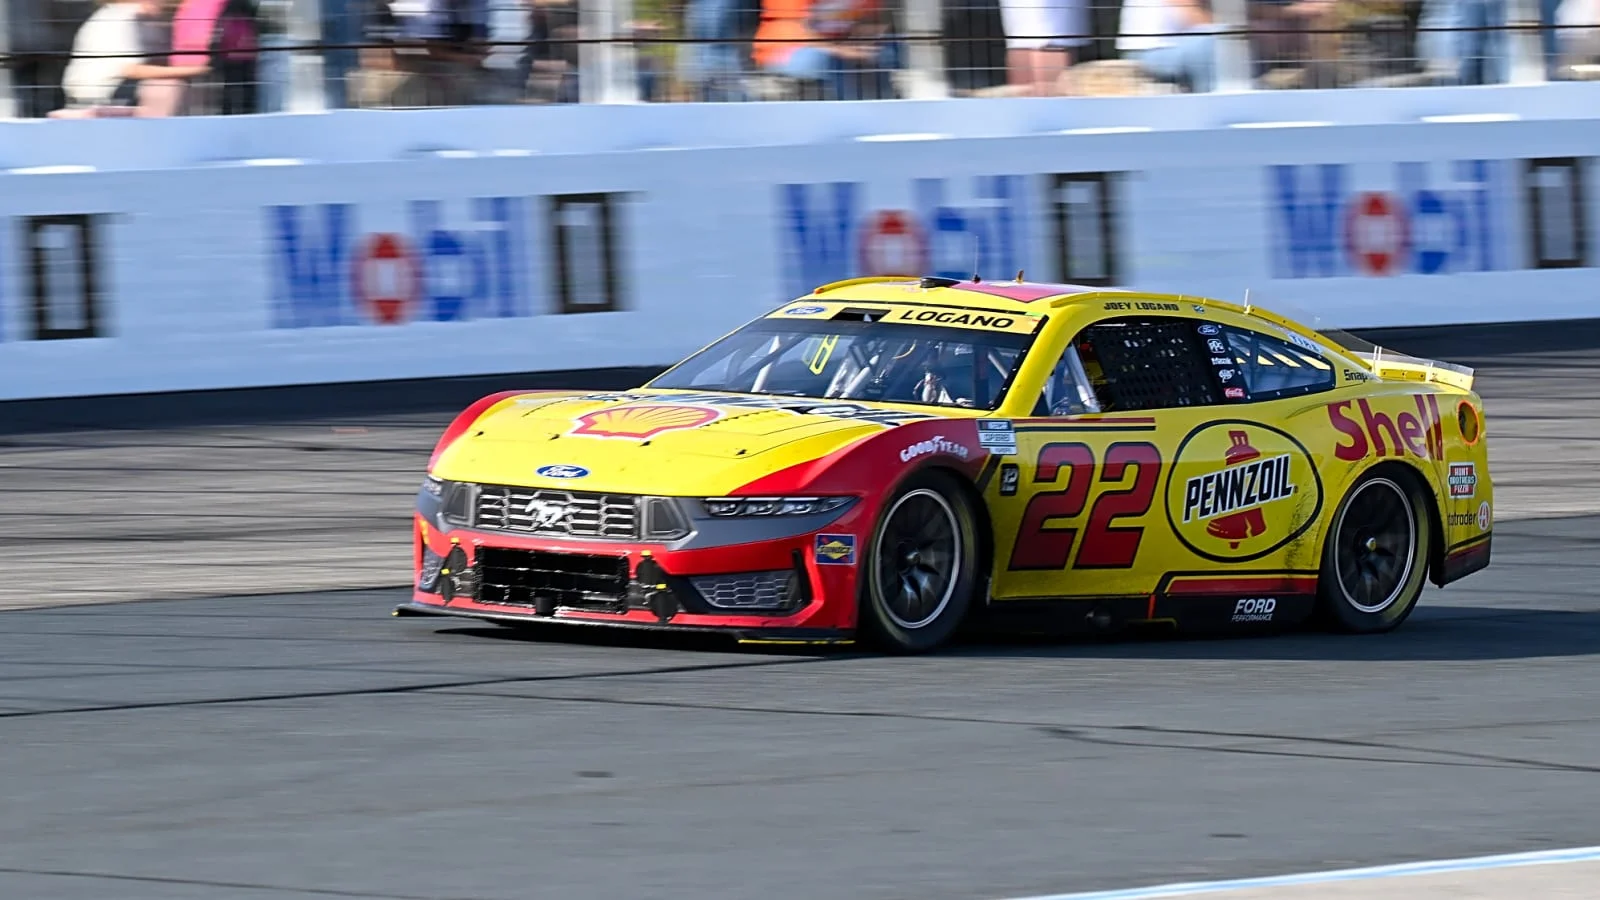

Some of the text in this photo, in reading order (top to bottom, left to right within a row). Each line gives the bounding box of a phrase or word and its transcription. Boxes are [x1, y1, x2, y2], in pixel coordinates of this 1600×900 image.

[1104, 302, 1180, 312] JOEY LOGANO
[900, 309, 1014, 329] LOGANO
[1327, 393, 1444, 461] Shell
[542, 465, 584, 479] Ford
[1185, 456, 1293, 521] PENNZOIL
[1008, 442, 1161, 571] 22
[1233, 598, 1277, 614] FORD
